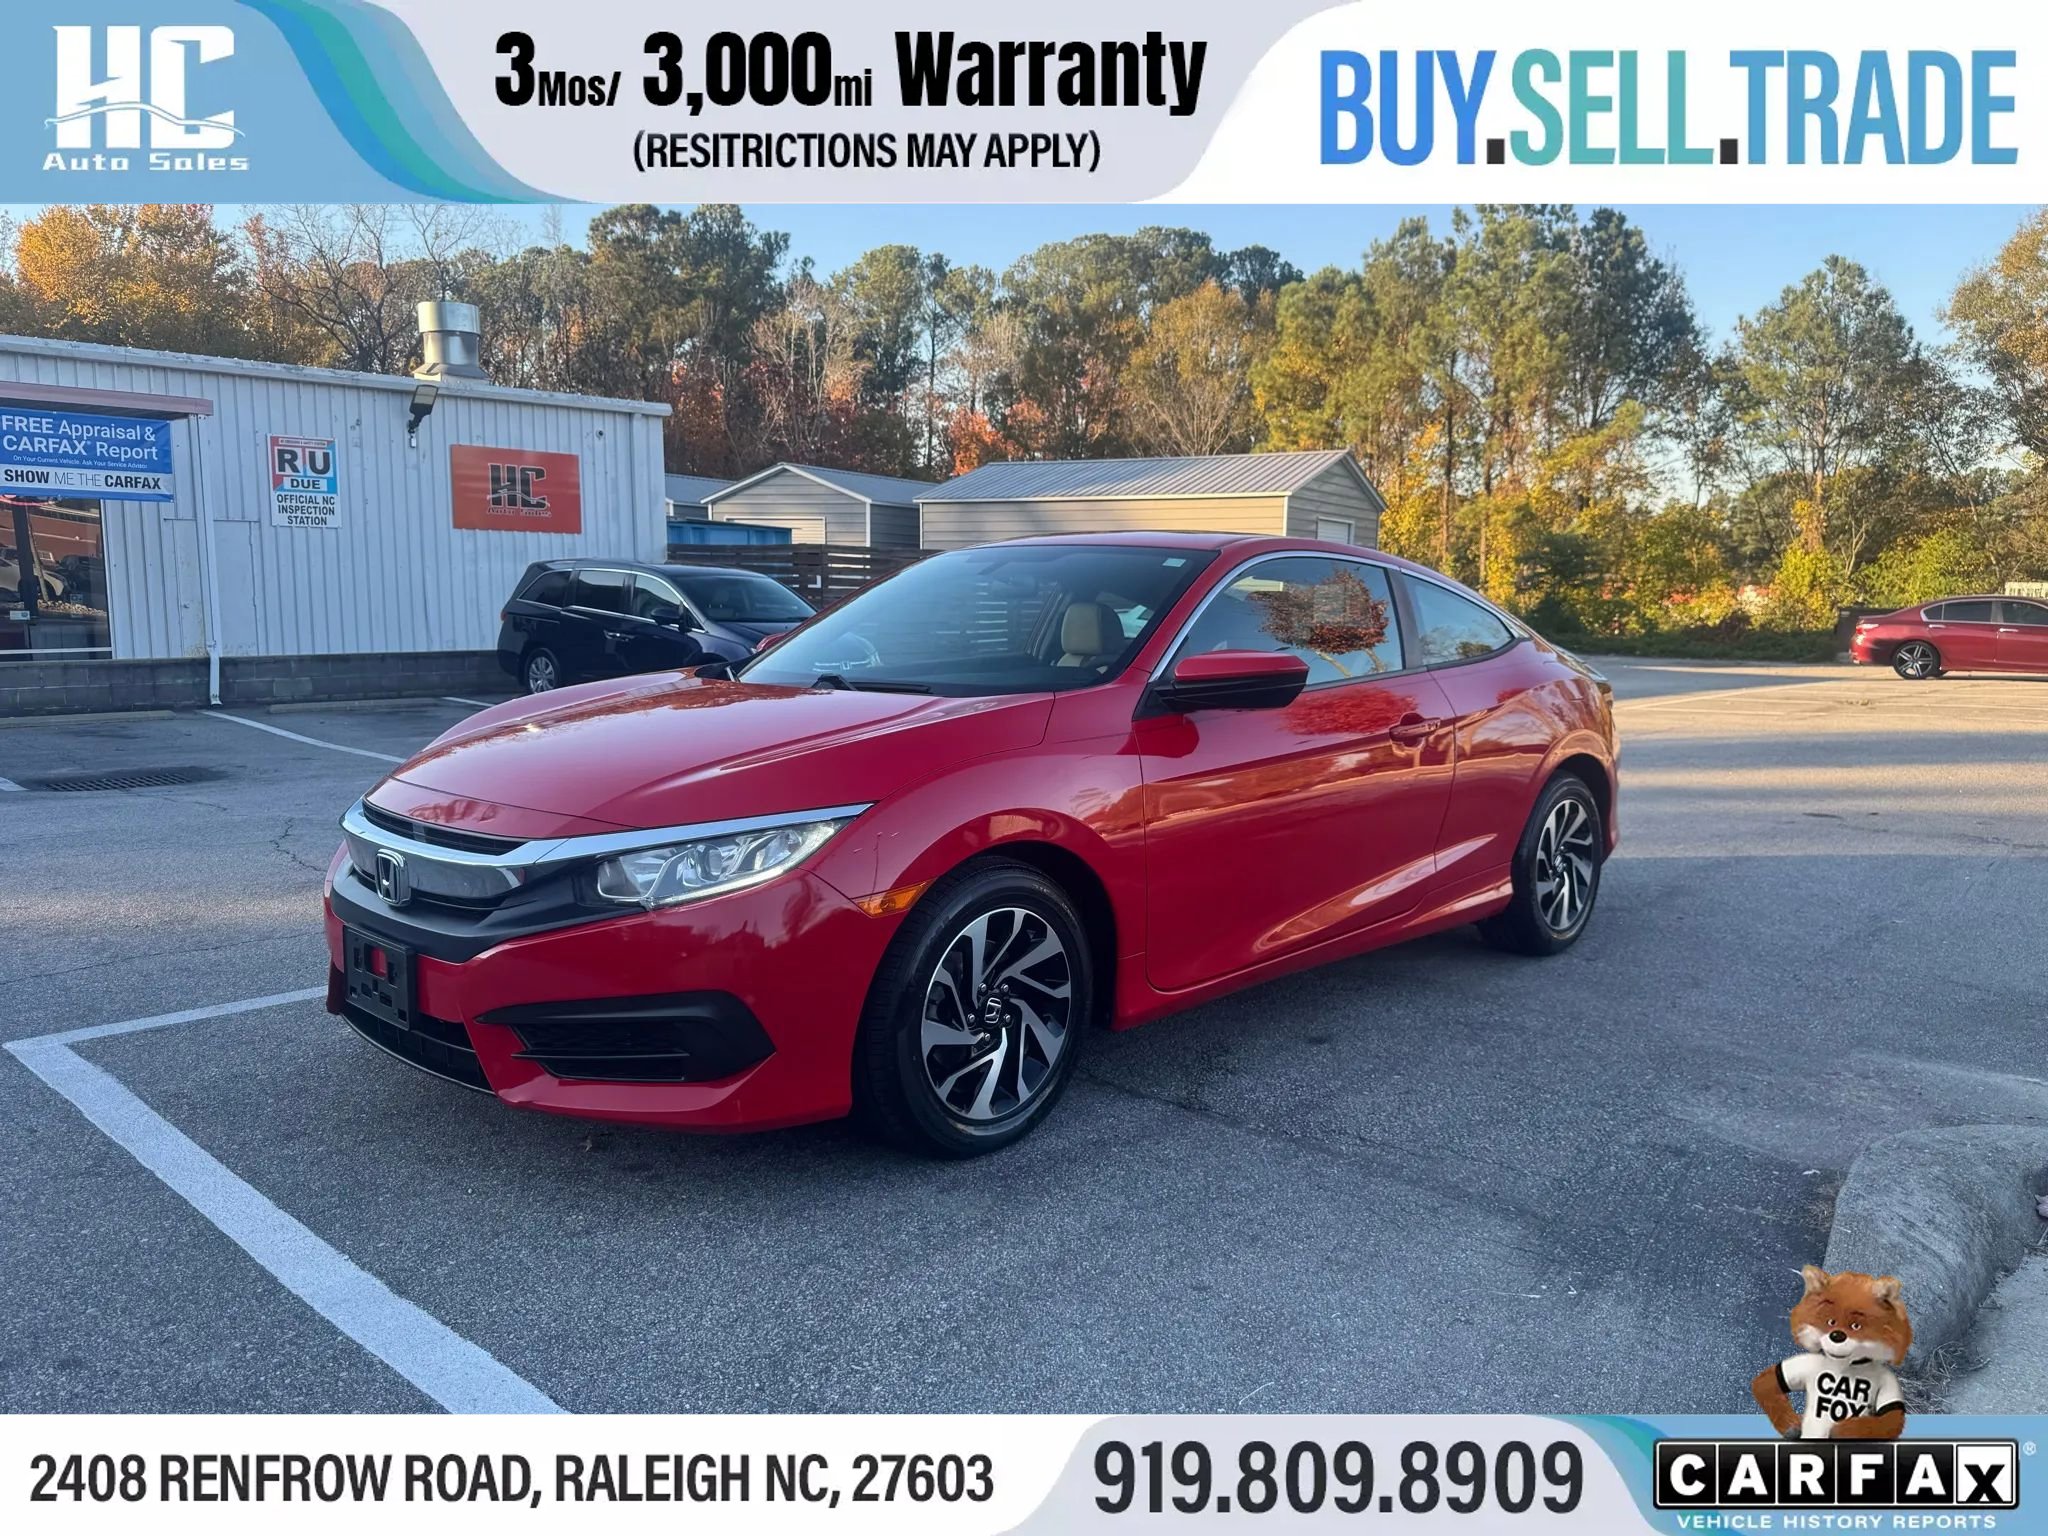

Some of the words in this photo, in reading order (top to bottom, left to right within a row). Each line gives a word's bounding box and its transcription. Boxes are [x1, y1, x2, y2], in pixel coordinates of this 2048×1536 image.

[1, 415, 54, 434] FREE
[58, 419, 141, 440] Appraisal
[144, 426, 156, 442] &
[2, 434, 88, 456] CARFAX
[96, 441, 158, 462] Report
[4, 468, 50, 484] SHOW
[54, 471, 75, 485] ME
[78, 473, 102, 487] THE
[104, 475, 161, 490] CARFAX
[290, 478, 321, 489] DUE
[487, 462, 550, 510] HC
[276, 493, 320, 505] OFFICIAL
[322, 496, 335, 506] NC
[278, 504, 335, 516] INSPECTION
[287, 515, 328, 526] STATION
